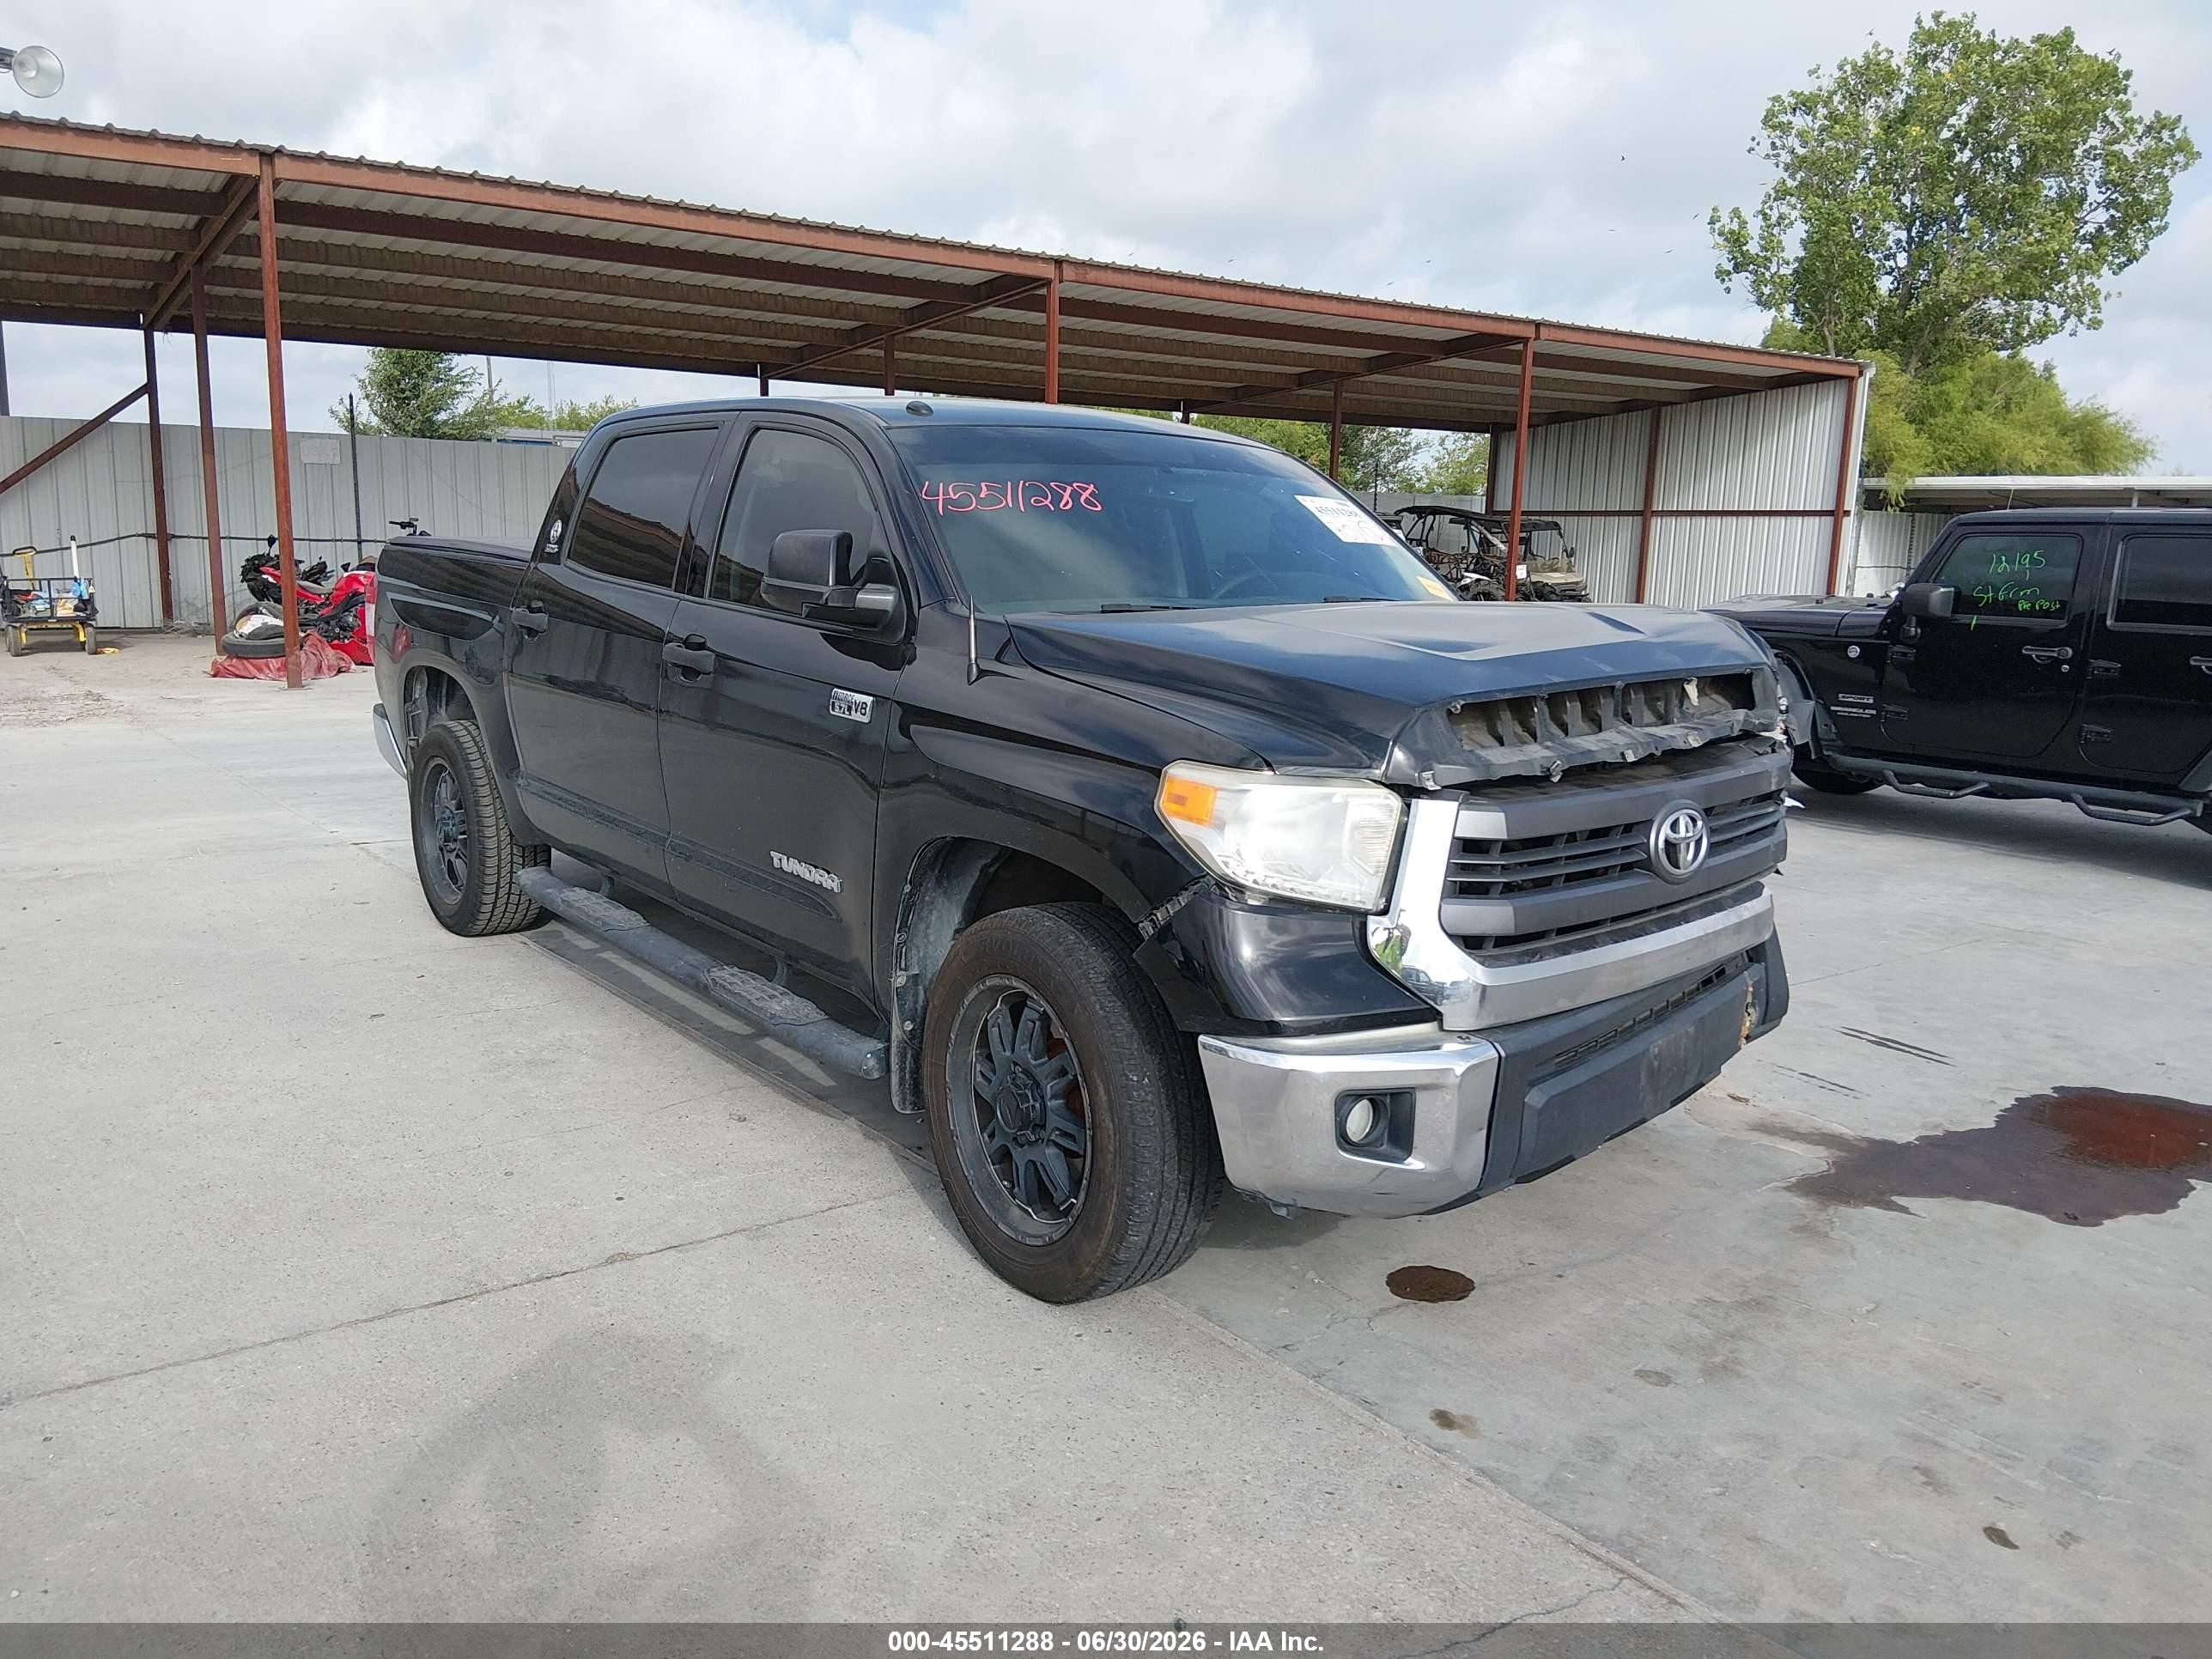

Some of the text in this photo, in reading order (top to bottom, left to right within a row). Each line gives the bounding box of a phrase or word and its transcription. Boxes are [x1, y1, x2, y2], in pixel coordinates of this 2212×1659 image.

[920, 480, 1103, 516] 45511288
[854, 699, 868, 716] V8
[770, 851, 842, 893] TUNDRA
